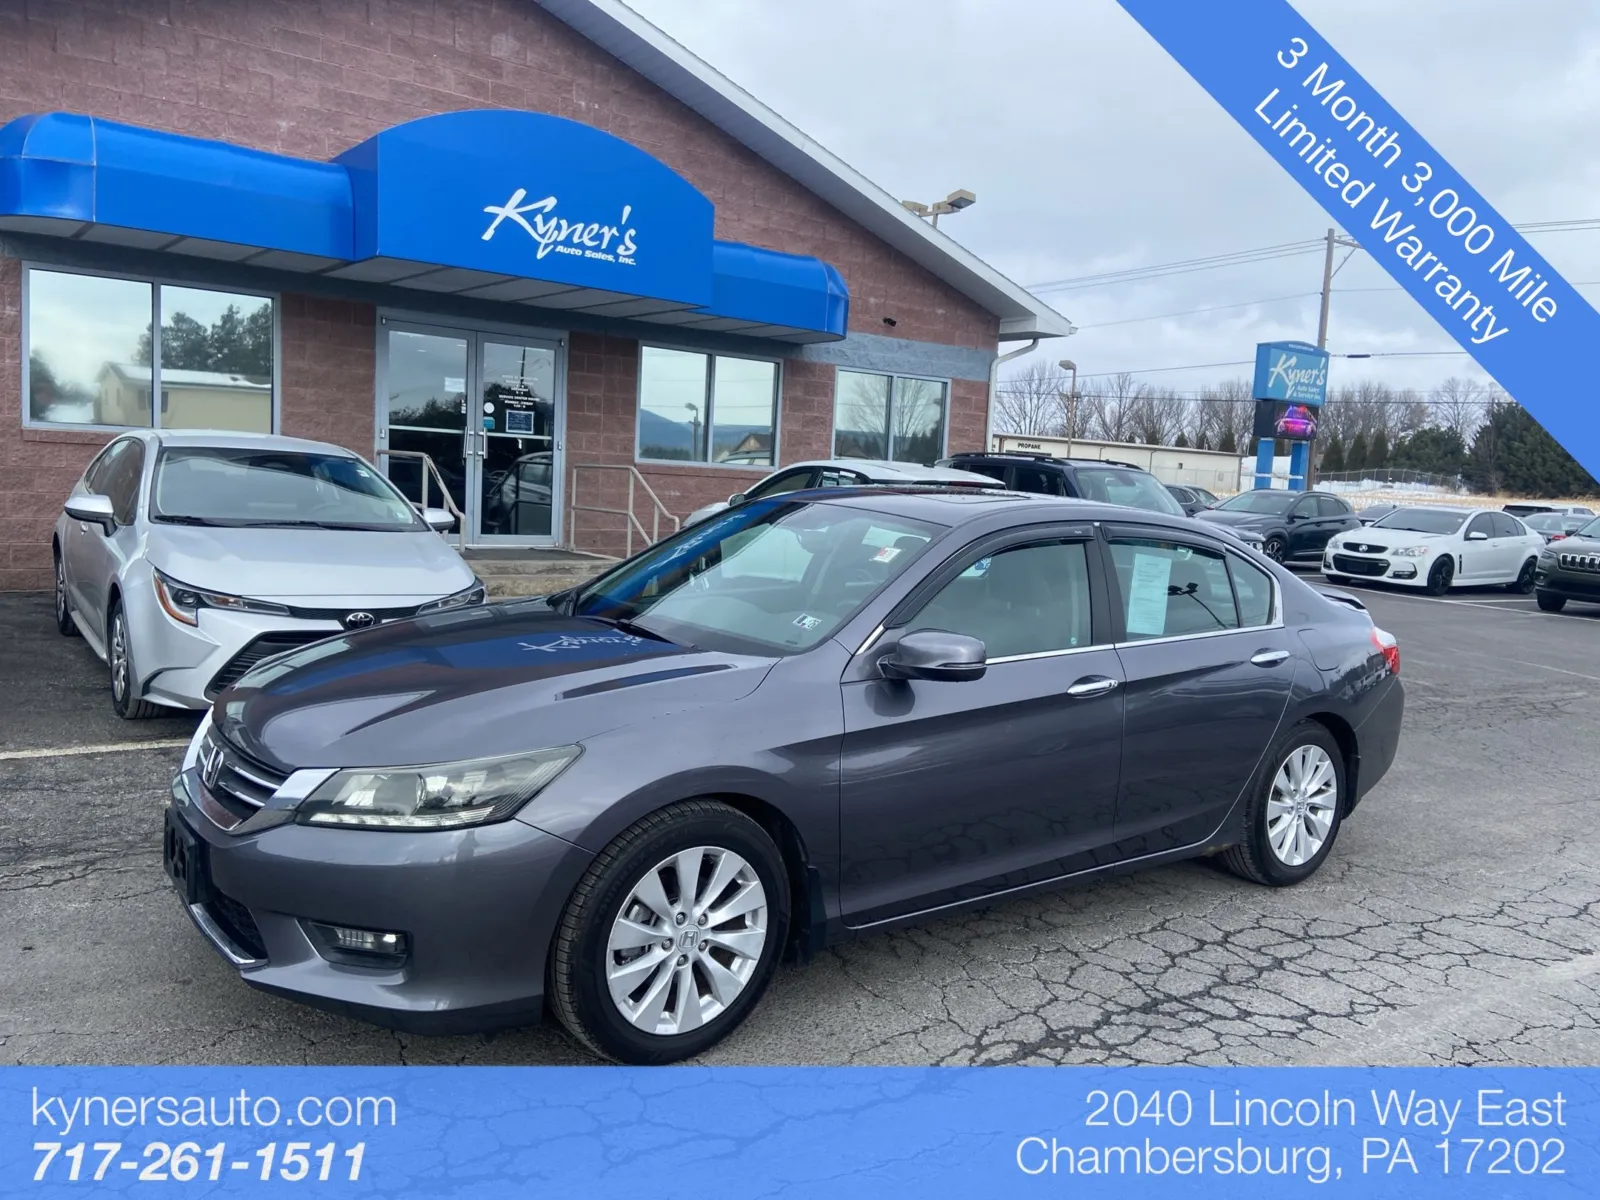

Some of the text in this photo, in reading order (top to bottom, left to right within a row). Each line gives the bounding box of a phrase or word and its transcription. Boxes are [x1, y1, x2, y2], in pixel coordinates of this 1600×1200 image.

[481, 187, 638, 260] Kyner's
[555, 245, 637, 266] Auto Sales, Inc.
[1268, 353, 1325, 399] Kyner's
